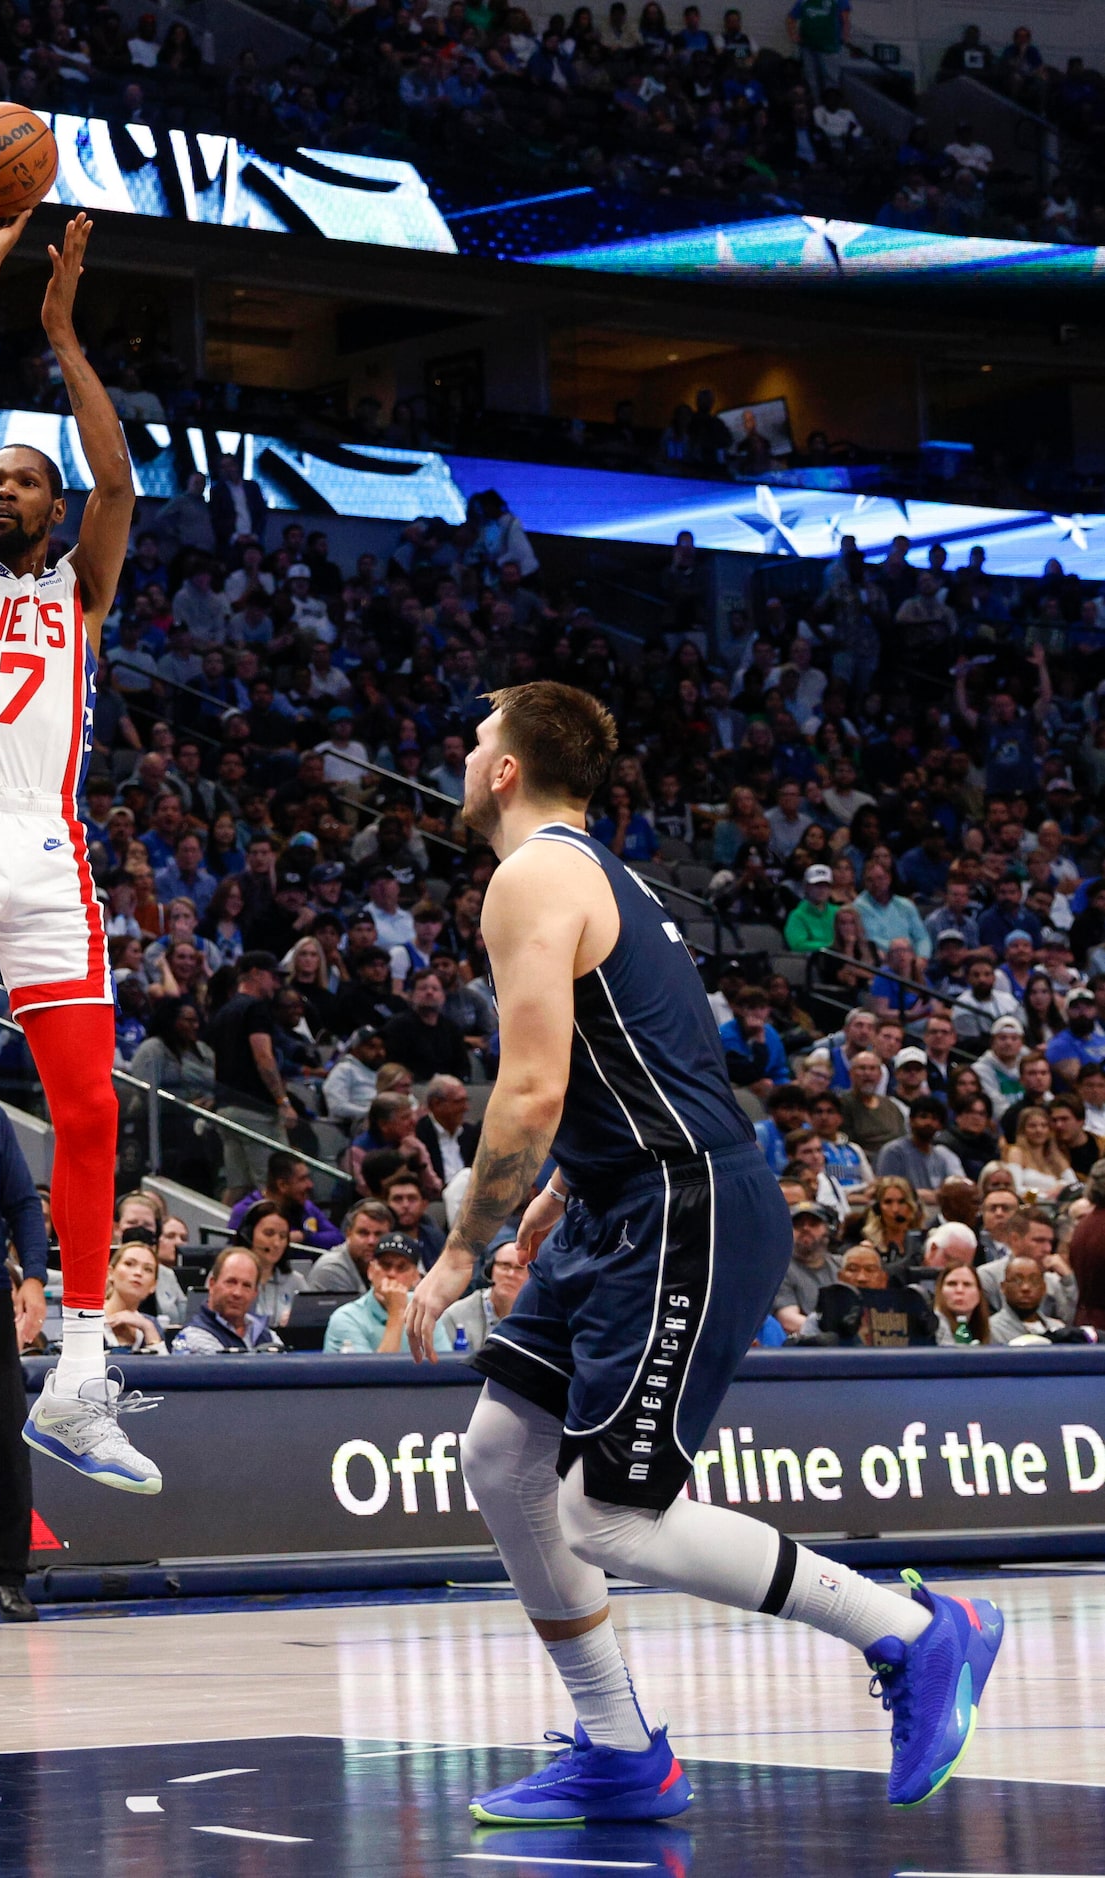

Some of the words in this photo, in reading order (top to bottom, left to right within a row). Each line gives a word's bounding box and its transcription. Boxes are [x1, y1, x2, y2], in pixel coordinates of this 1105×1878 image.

[38, 577, 63, 588] Webull
[627, 1294, 690, 1482] MAVERICKS
[860, 1422, 928, 1499] of
[940, 1422, 1048, 1497] the
